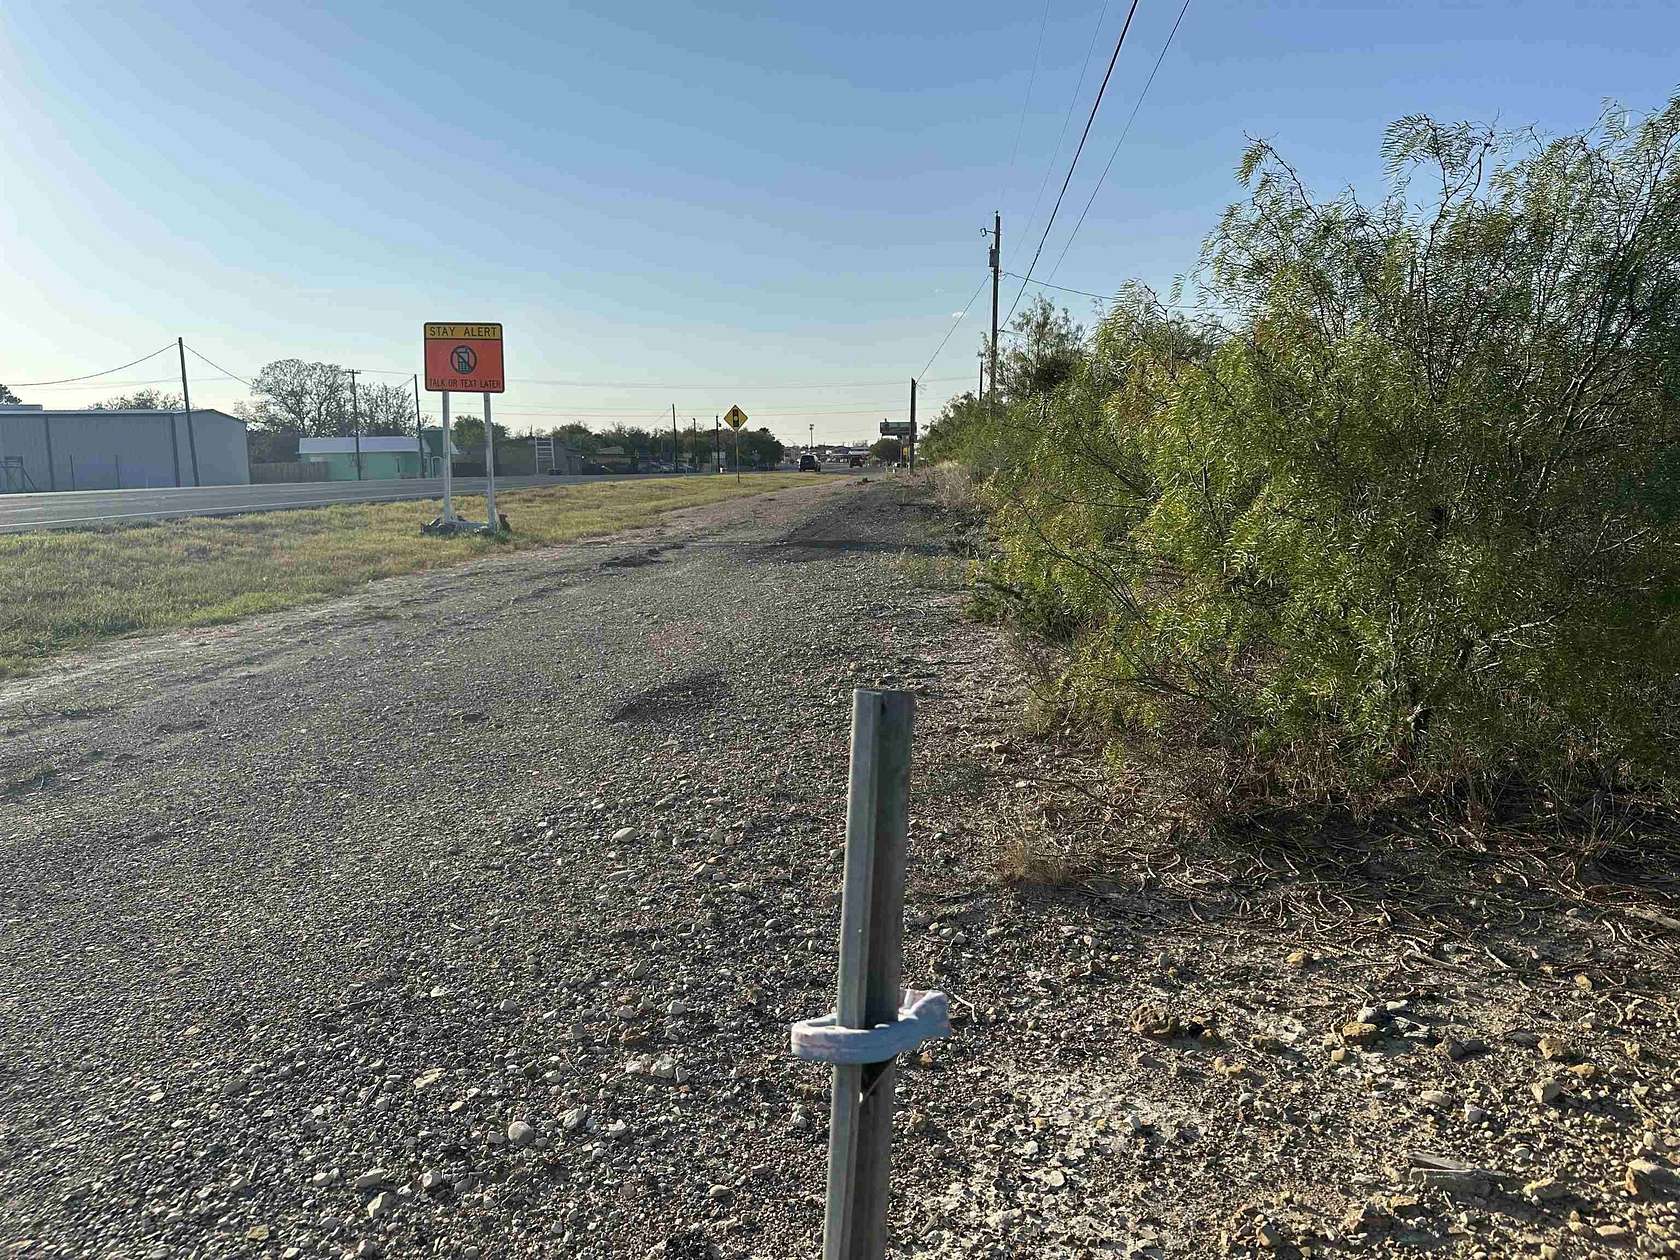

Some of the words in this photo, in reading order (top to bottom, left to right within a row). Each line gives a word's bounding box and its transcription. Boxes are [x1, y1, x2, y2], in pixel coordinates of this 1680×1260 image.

[429, 326, 456, 337] STAY
[463, 326, 497, 337] ALERT
[448, 378, 458, 388] OR
[459, 378, 477, 388] TEXT
[480, 379, 501, 389] LATER
